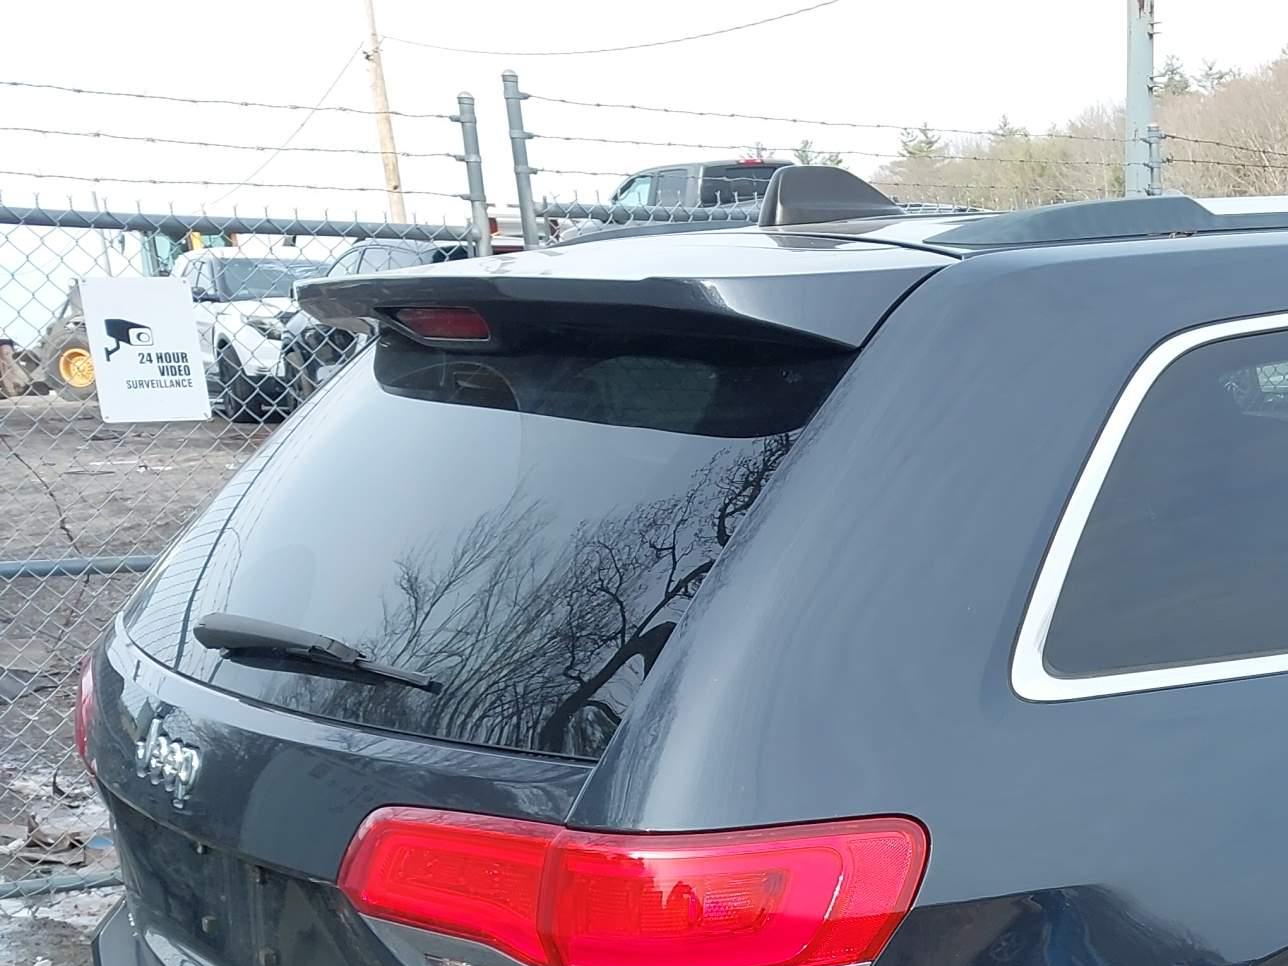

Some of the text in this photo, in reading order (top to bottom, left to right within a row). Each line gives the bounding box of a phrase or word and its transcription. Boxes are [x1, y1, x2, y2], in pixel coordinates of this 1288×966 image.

[138, 352, 189, 364] 24 HOUR
[158, 365, 191, 377] VIDEO
[126, 379, 193, 389] SURVEILLANCE
[135, 718, 200, 809] Jeep
